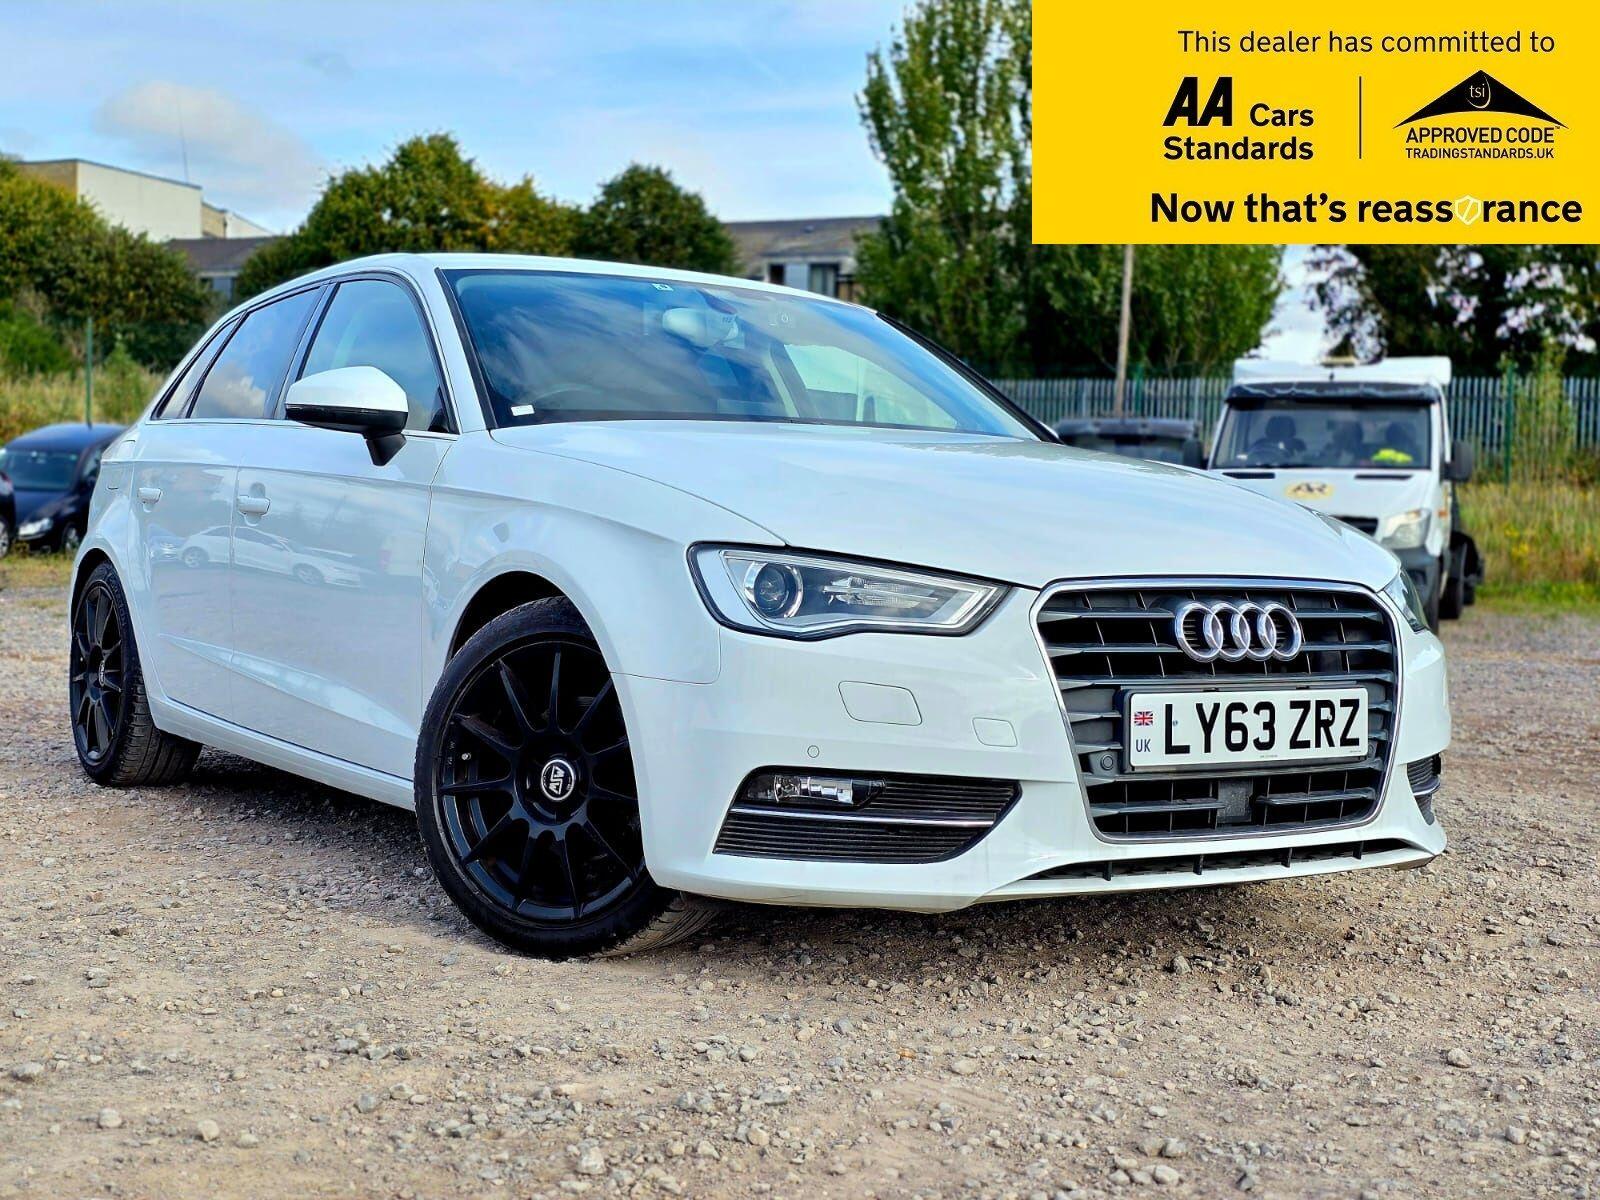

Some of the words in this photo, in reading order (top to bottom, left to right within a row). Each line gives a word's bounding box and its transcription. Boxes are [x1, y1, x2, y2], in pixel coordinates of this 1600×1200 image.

[1165, 702, 1276, 755] LY63
[1289, 698, 1360, 750] ZRZ
[1135, 738, 1151, 753] UK
